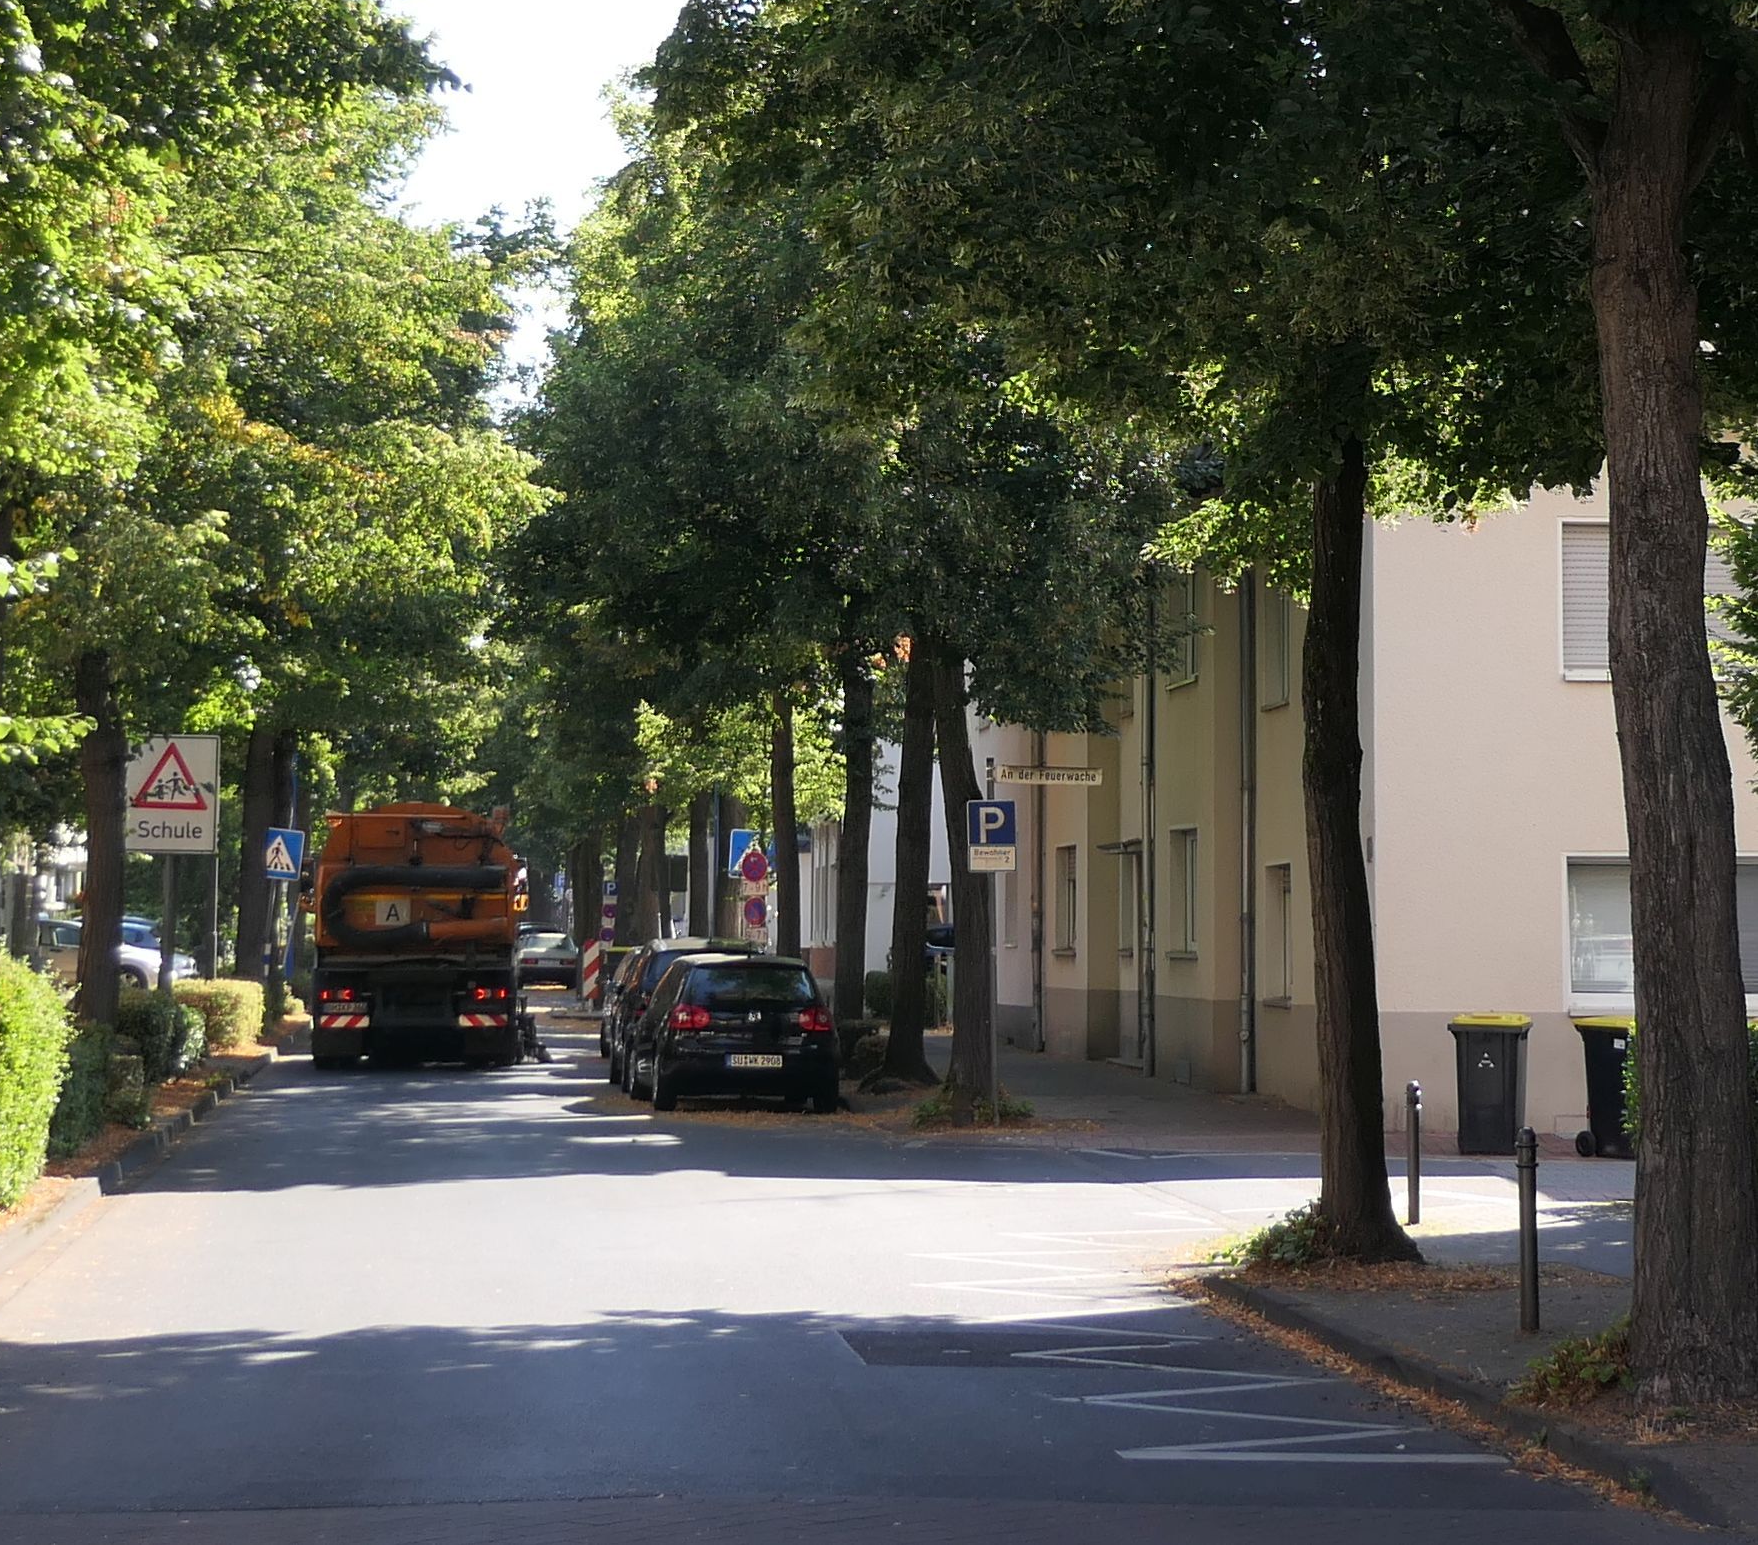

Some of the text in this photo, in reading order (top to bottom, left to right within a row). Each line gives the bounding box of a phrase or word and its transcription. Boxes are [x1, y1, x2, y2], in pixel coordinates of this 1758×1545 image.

[1001, 769, 1097, 782] An der Feuerwache
[138, 820, 202, 839] Schule
[980, 807, 1004, 843] P
[607, 883, 616, 894] P
[386, 903, 400, 922] A
